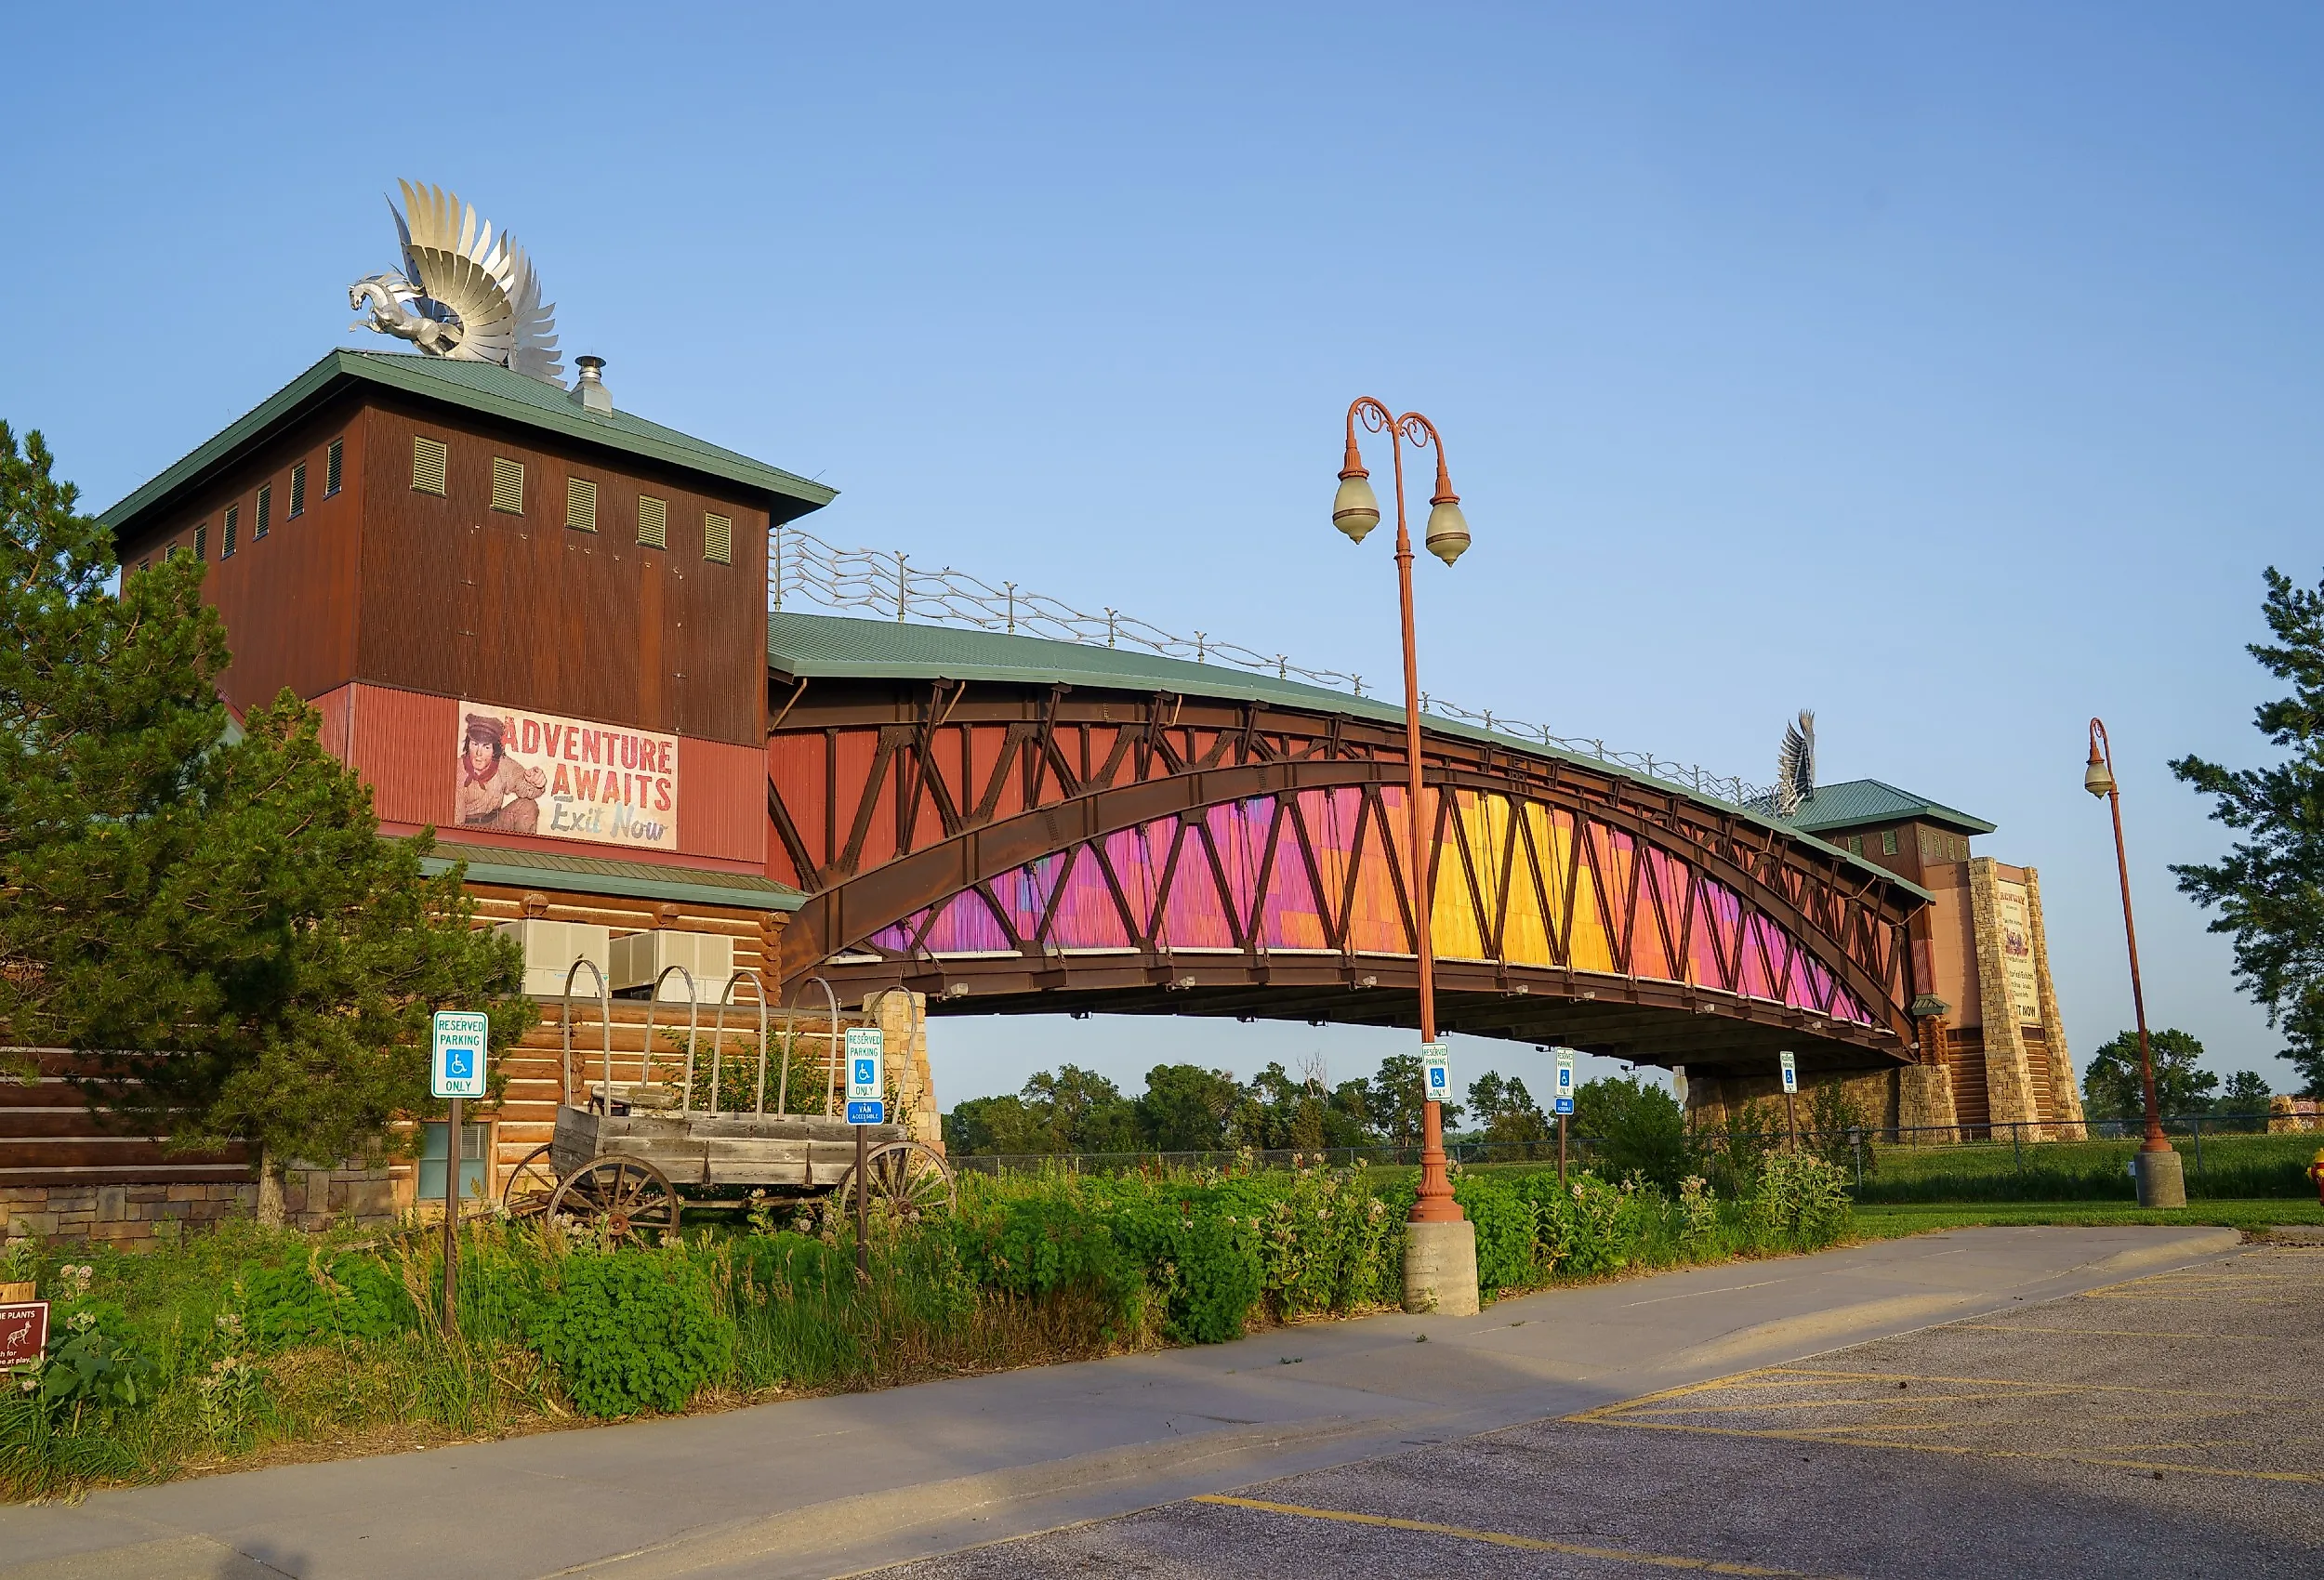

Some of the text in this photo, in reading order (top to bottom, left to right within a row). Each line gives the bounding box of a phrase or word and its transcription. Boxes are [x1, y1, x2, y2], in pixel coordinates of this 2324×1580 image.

[501, 716, 673, 775] ADVENTURE
[551, 763, 671, 811] AWAITS
[550, 796, 669, 842] Exit Now
[439, 1020, 484, 1032] RESERVED
[440, 1034, 480, 1047] PARKING
[849, 1034, 880, 1045] RESERVED
[850, 1047, 878, 1057] PARKING
[1425, 1058, 1446, 1066] PARKING
[446, 1081, 471, 1092] ONLY
[855, 1086, 874, 1096] ONLY
[858, 1105, 872, 1113] VAN
[7, 1310, 35, 1320] PLANTS
